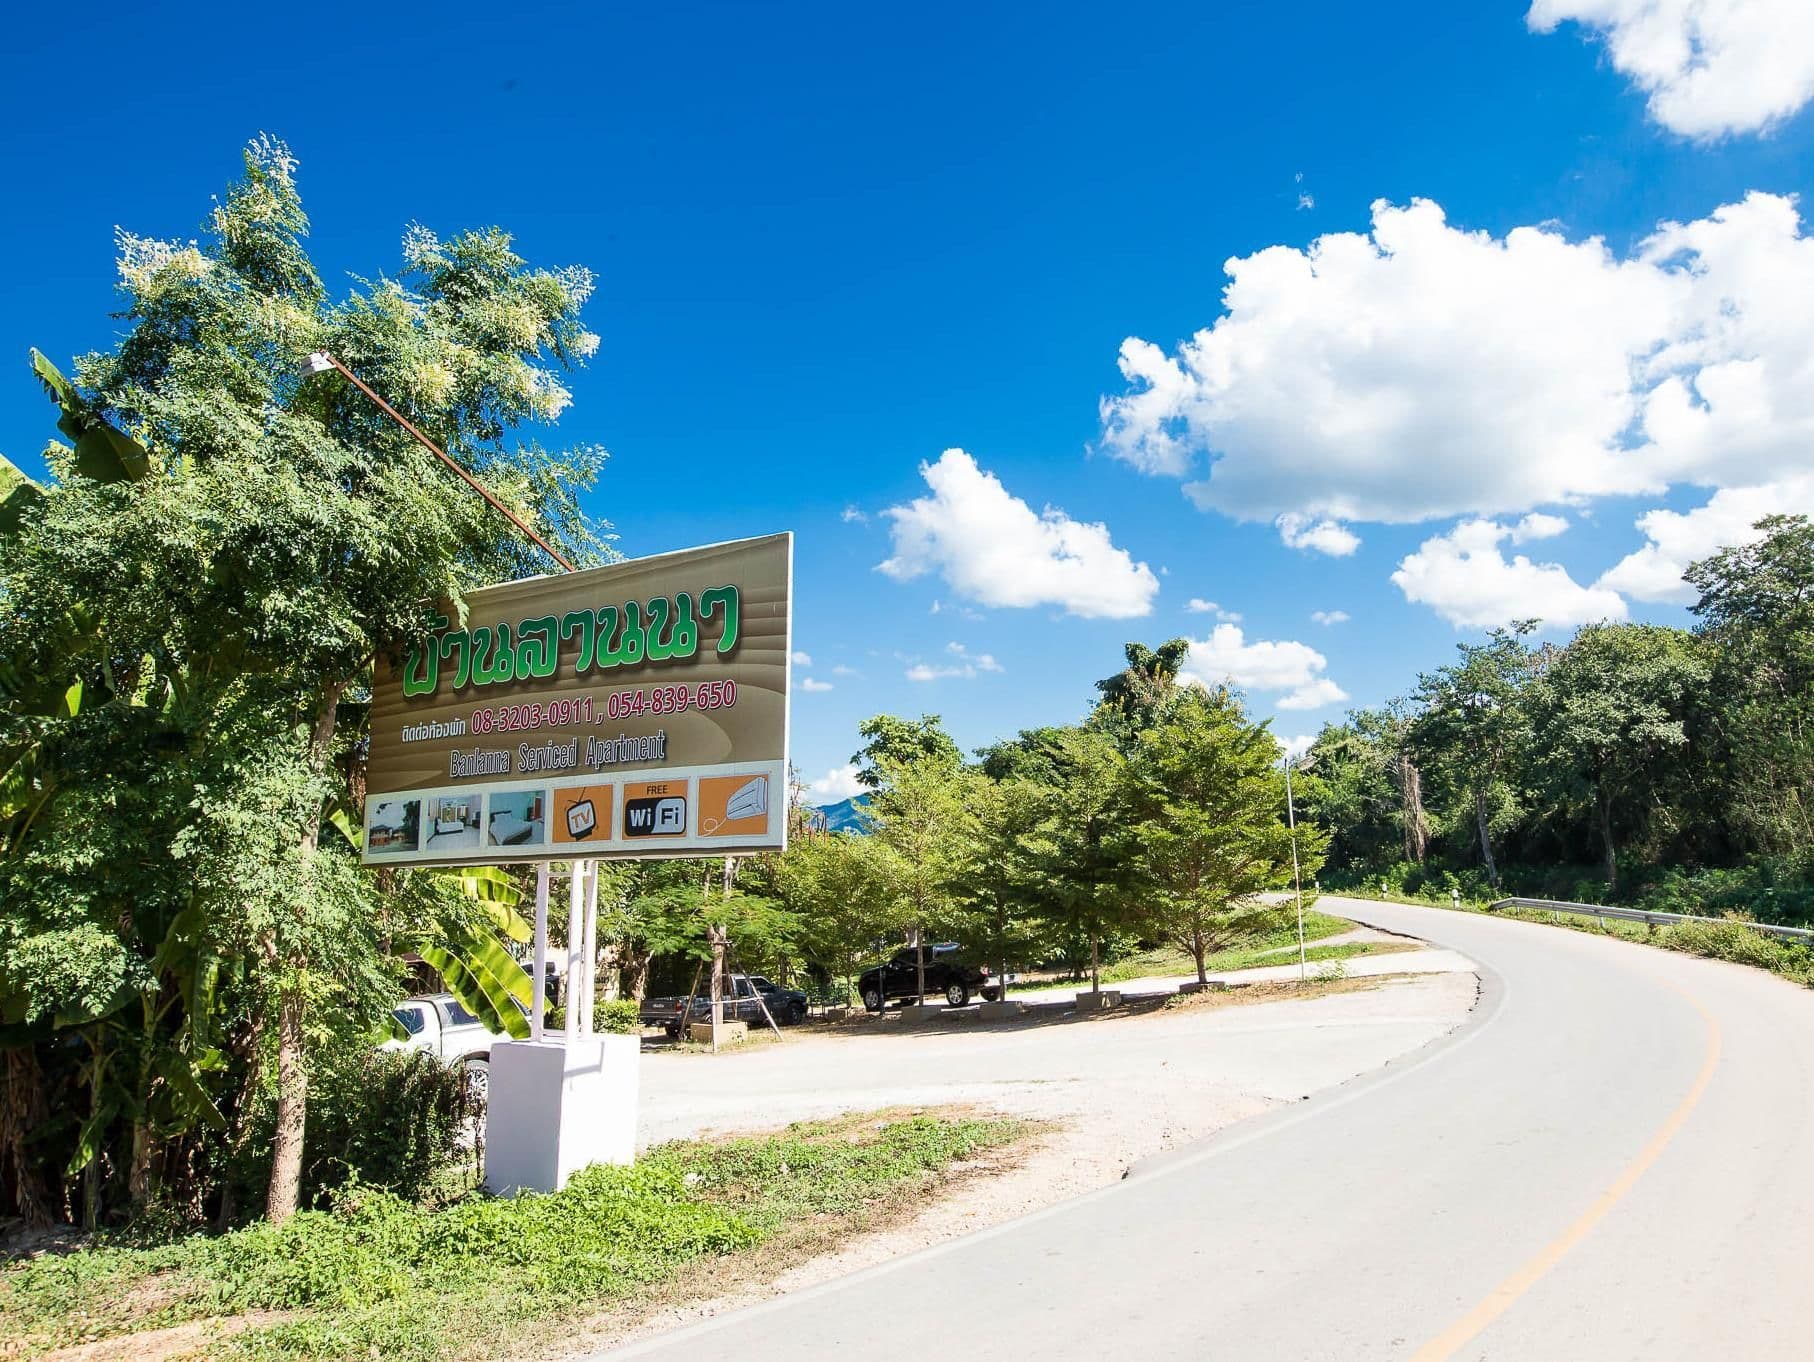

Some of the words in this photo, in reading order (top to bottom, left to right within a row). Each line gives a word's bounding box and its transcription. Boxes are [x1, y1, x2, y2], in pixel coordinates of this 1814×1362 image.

[403, 584, 739, 698] บ้านลานนา
[402, 717, 466, 743] ติดต่อห้องพัก
[608, 679, 736, 719] 054-839-650
[449, 747, 510, 778] Banlanna
[518, 738, 577, 772] Serviced
[585, 729, 665, 769] Apartment
[646, 784, 669, 795] FREE
[570, 808, 592, 829] TV
